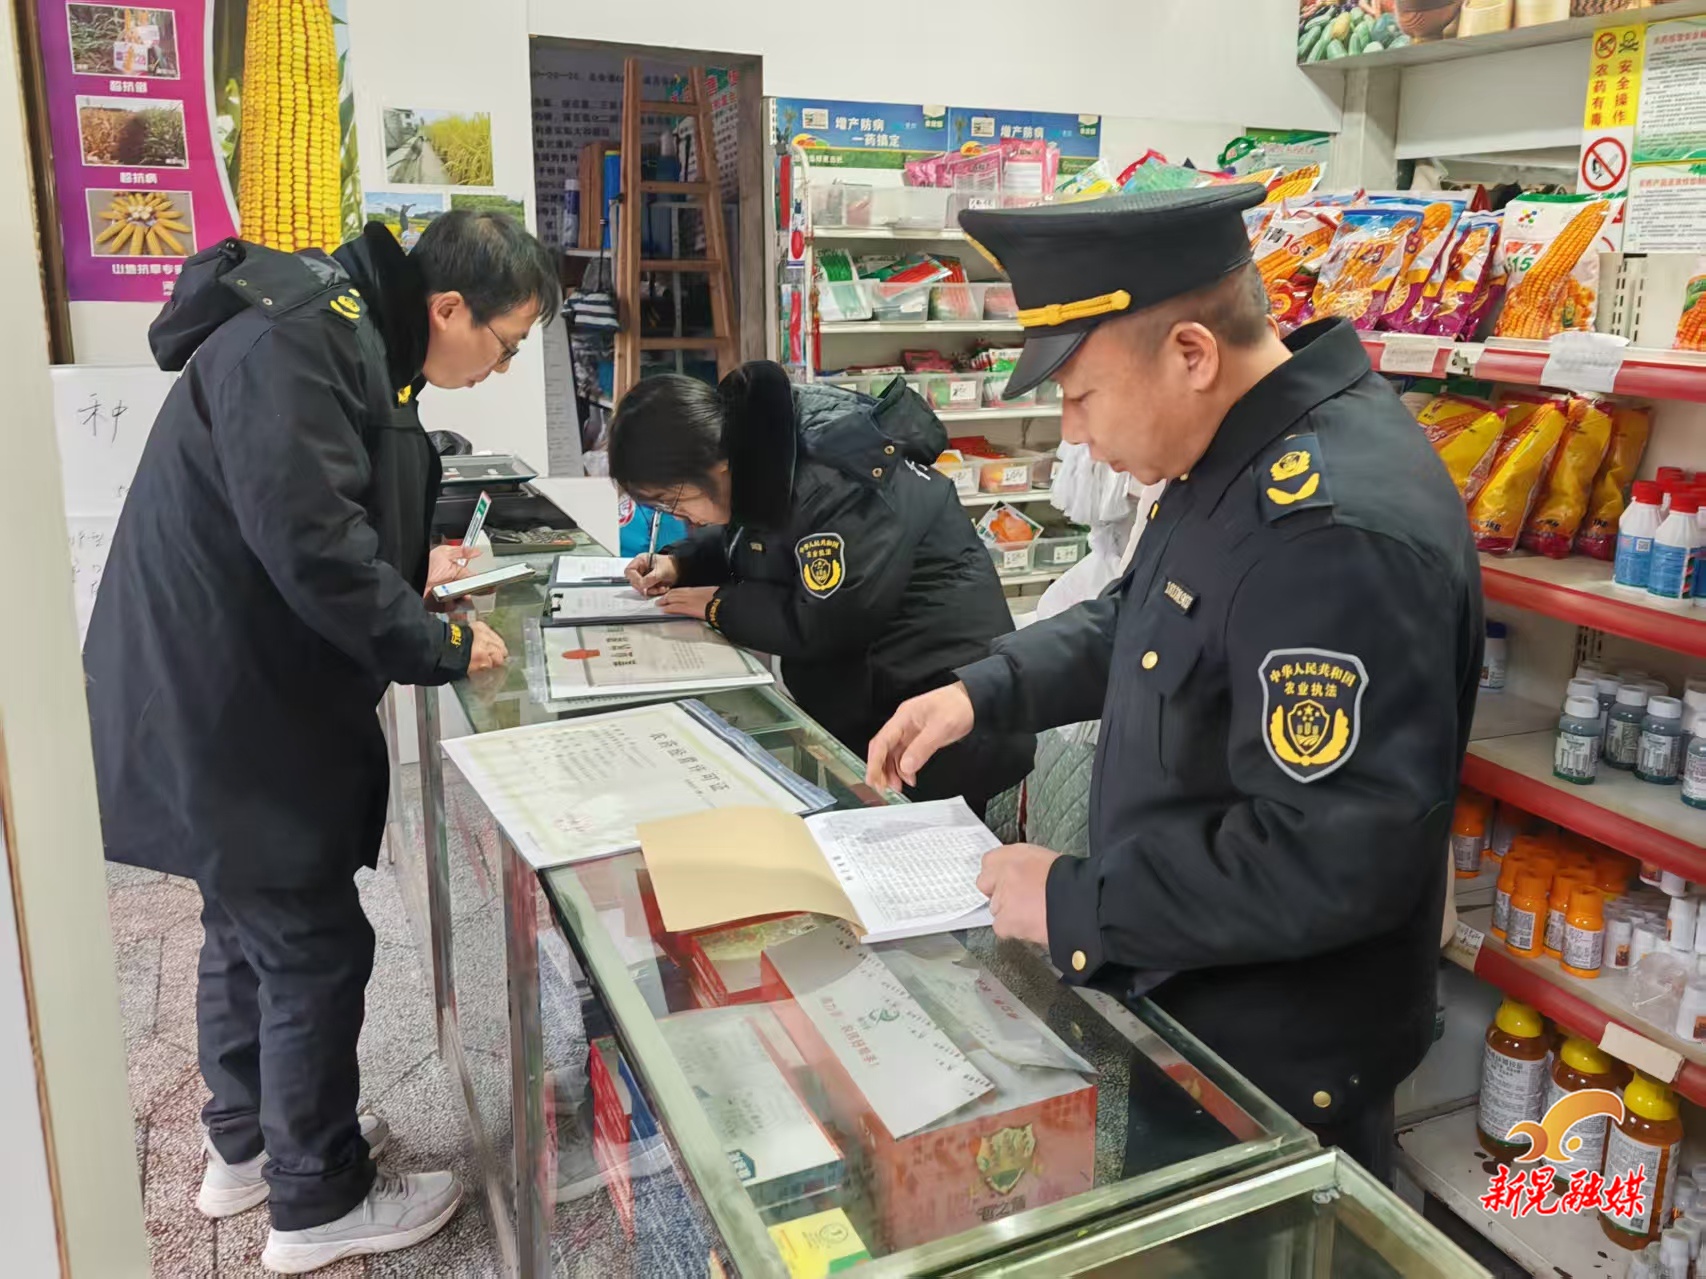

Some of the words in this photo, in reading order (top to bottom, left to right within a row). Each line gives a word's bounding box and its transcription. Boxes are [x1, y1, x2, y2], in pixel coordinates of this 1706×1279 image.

[1592, 63, 1608, 126] 农药有毒
[1613, 60, 1632, 124] 安全操作
[835, 116, 885, 132] 增产防病
[851, 133, 900, 148] 一药搞定
[1269, 662, 1357, 688] 中华人民共和国
[1284, 681, 1338, 698] 农业执法
